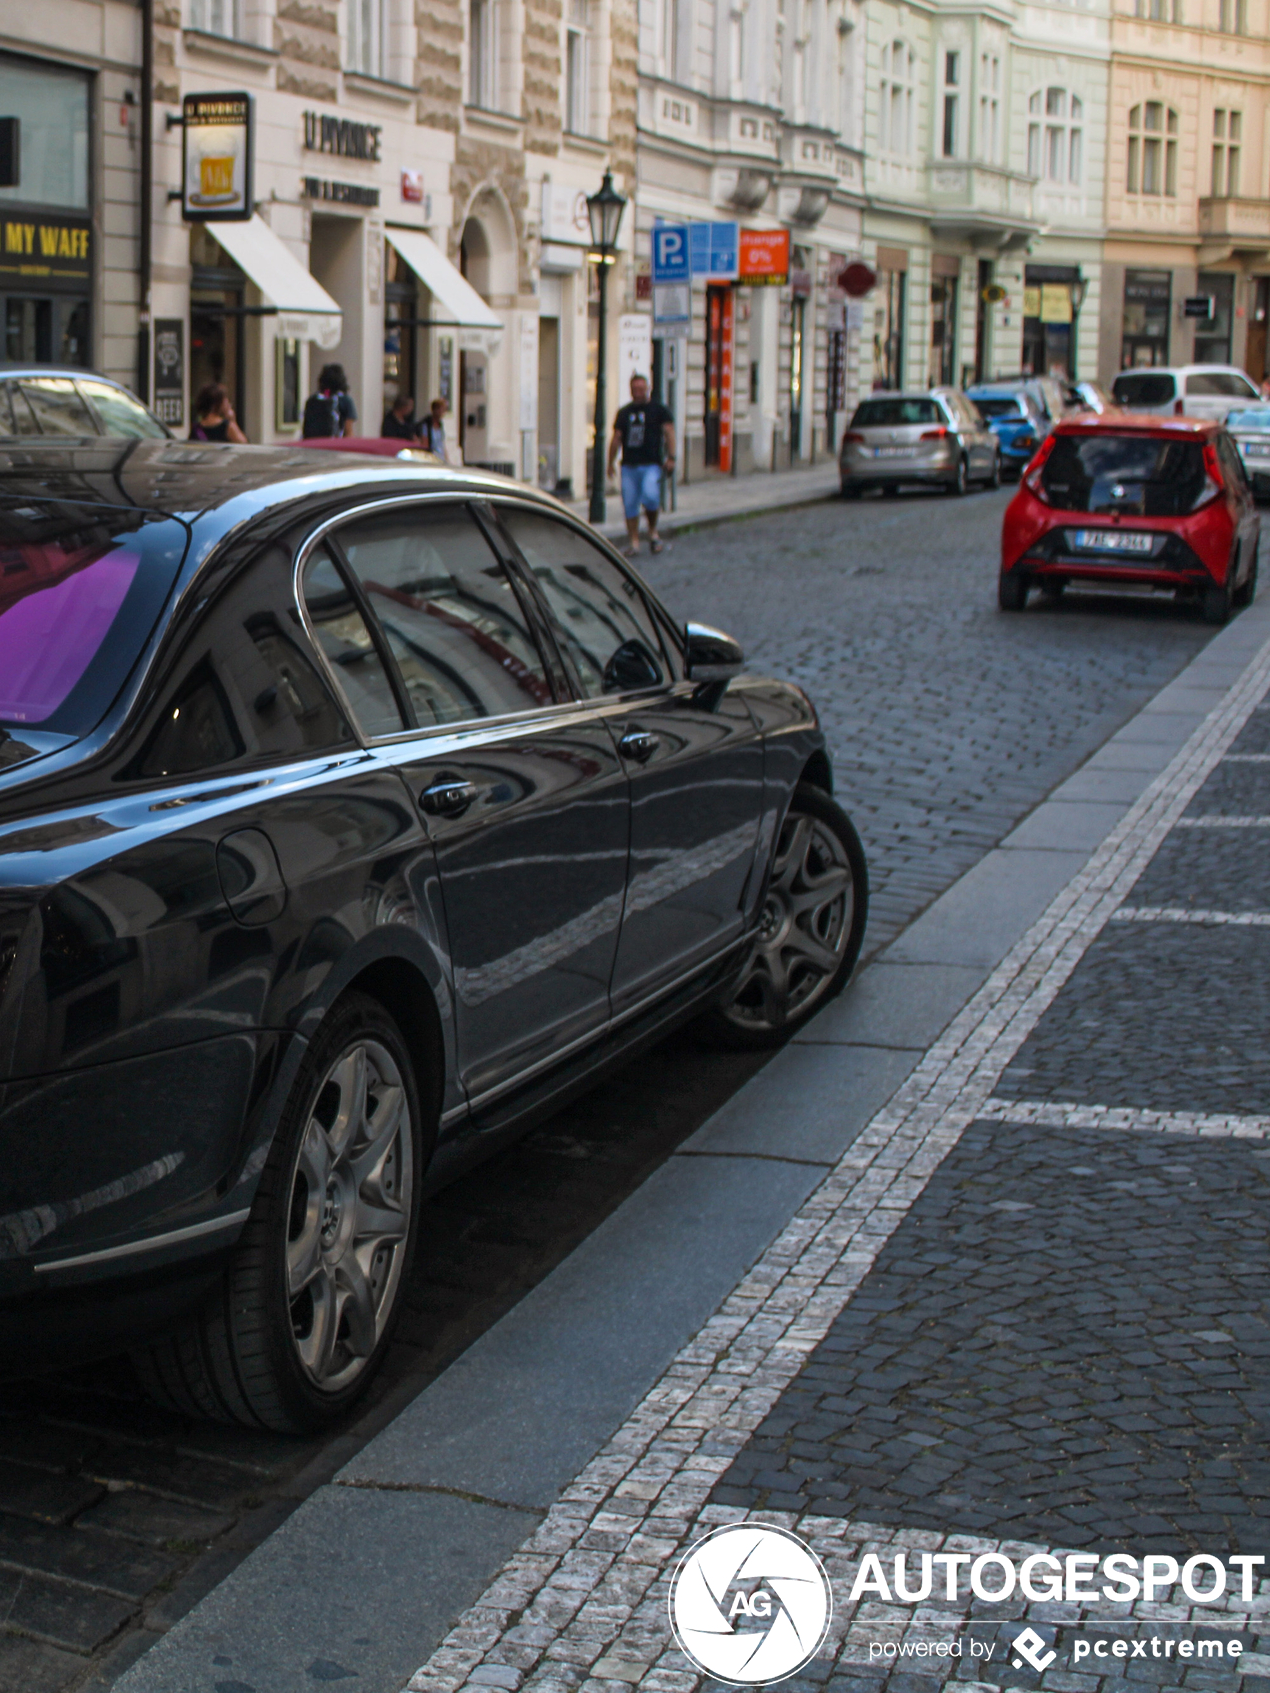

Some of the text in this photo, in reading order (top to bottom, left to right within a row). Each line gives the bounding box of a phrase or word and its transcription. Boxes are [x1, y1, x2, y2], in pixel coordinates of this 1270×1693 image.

[5, 222, 35, 255] MY
[39, 225, 89, 259] WAFF
[659, 232, 682, 266] P
[156, 399, 183, 421] BEER
